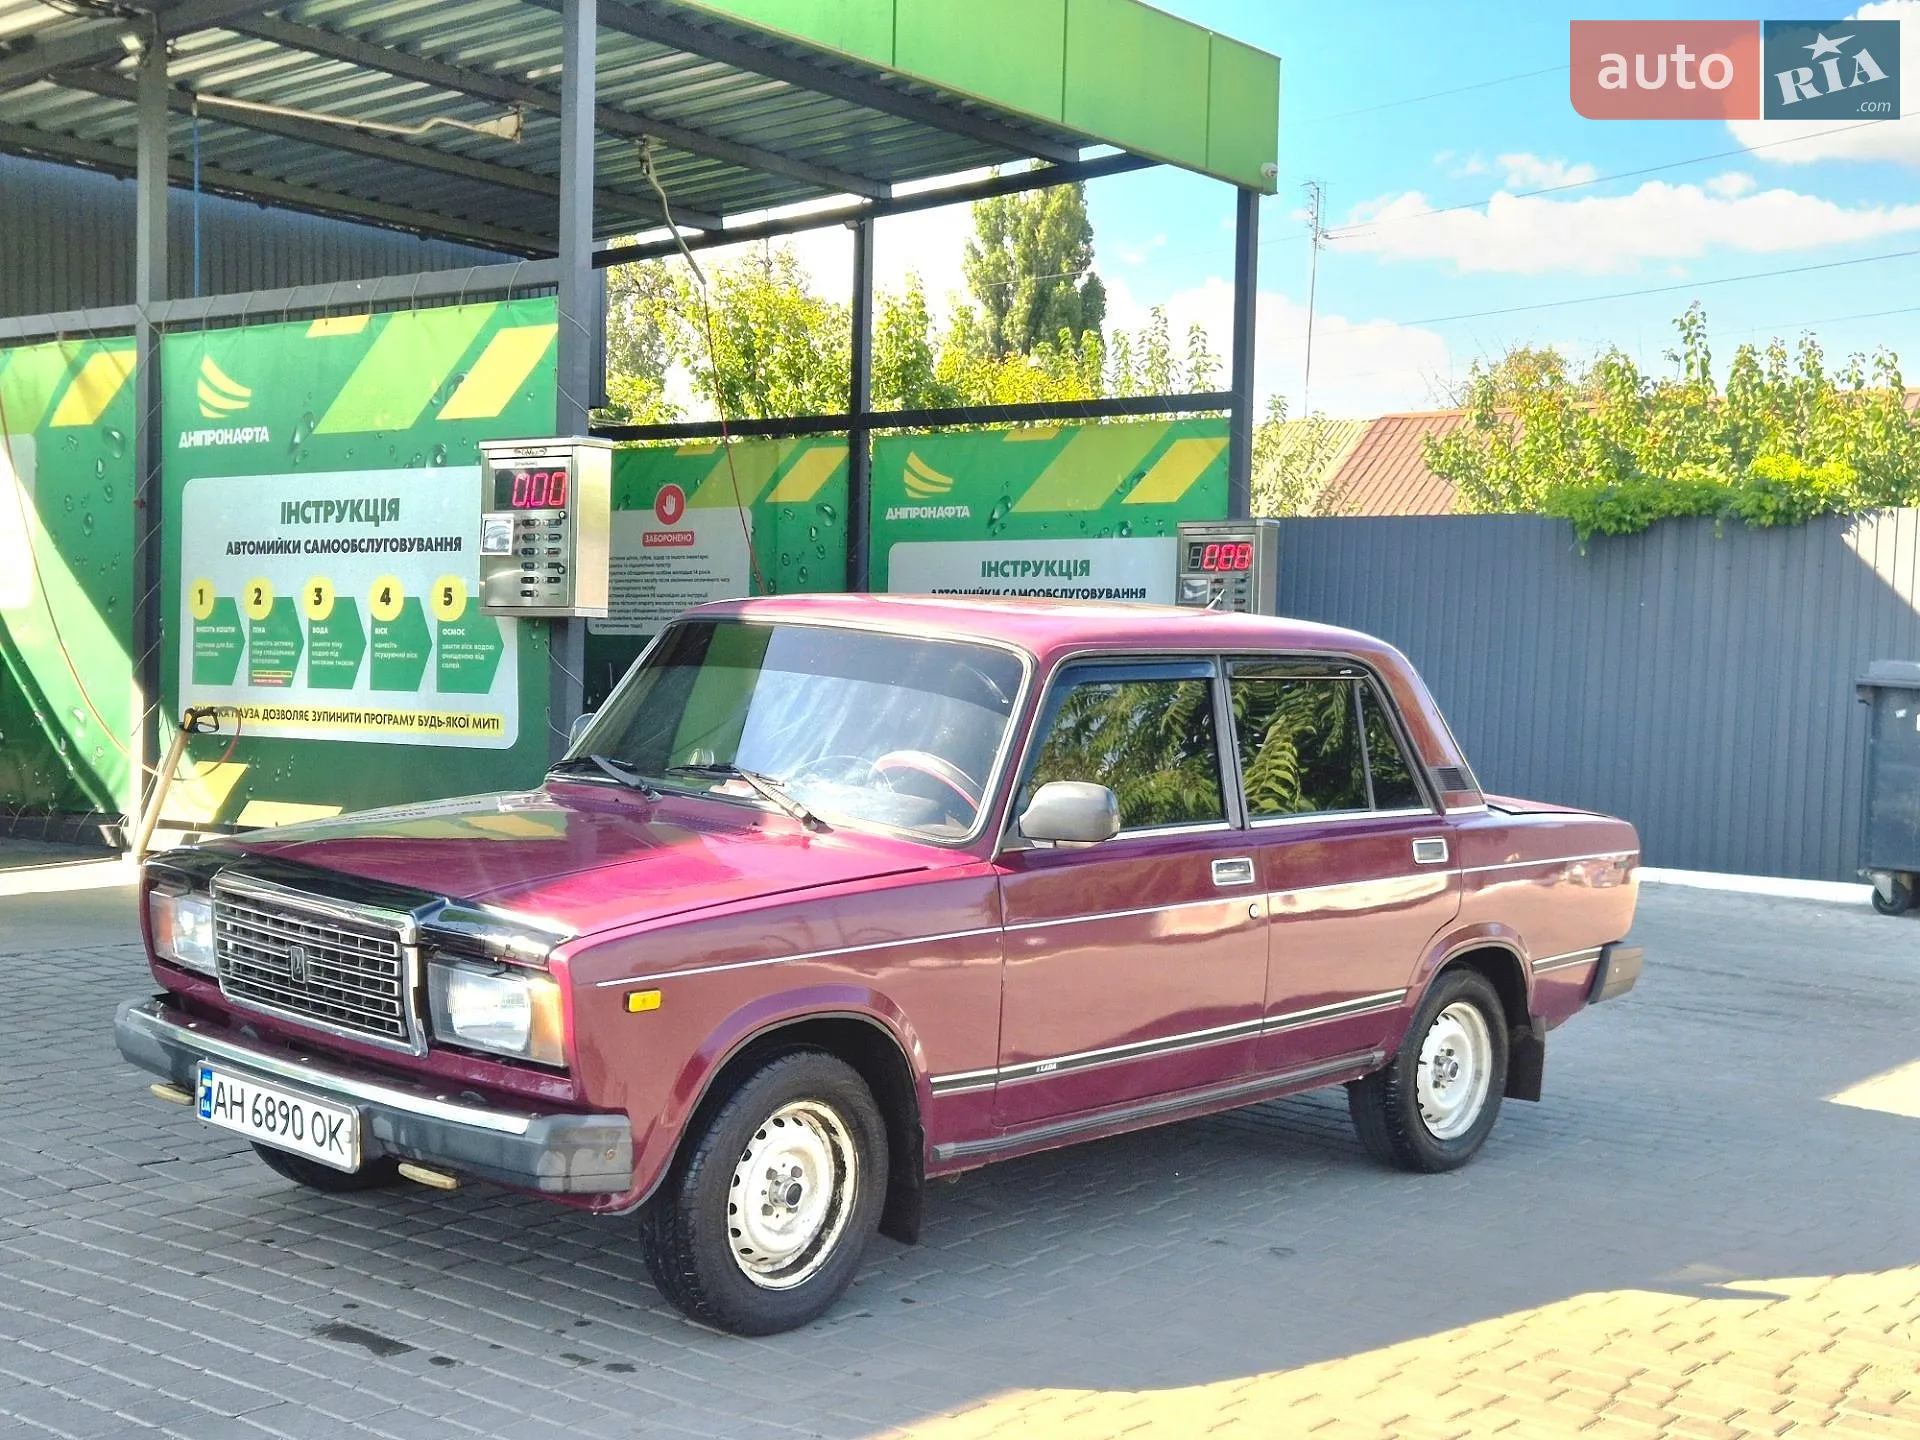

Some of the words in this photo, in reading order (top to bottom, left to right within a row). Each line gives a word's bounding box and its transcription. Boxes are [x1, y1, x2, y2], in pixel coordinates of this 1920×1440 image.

[178, 425, 270, 449] ДНІПРОНАФТА
[280, 497, 401, 527] ІНСТРУКЦІЯ
[885, 505, 971, 520] ДНІПРОНАФТА
[225, 536, 301, 556] АВТОМИЙКИ
[303, 535, 463, 554] САМООБСЛУГОВУВАННЯ
[644, 532, 692, 543] ЗАБОРОНЕНО
[981, 558, 1091, 580] ІНСТРУКЦІЯ
[198, 588, 204, 606] 1
[253, 587, 262, 606] 2
[313, 587, 323, 606] 3
[380, 587, 391, 606] 4
[443, 587, 453, 606] 5
[442, 628, 466, 636] ОСМОС
[262, 708, 309, 722] ДОЗВОЛЯЄ
[311, 710, 362, 724] ЗУПИНИТИ
[364, 712, 415, 727] ПРОГРАМУ
[417, 713, 470, 729] БУДЬ-ЯКОЇ
[472, 717, 500, 730] МИТІ
[213, 1081, 245, 1124] AH
[252, 1093, 304, 1141] 6890
[311, 1110, 345, 1155] OK
